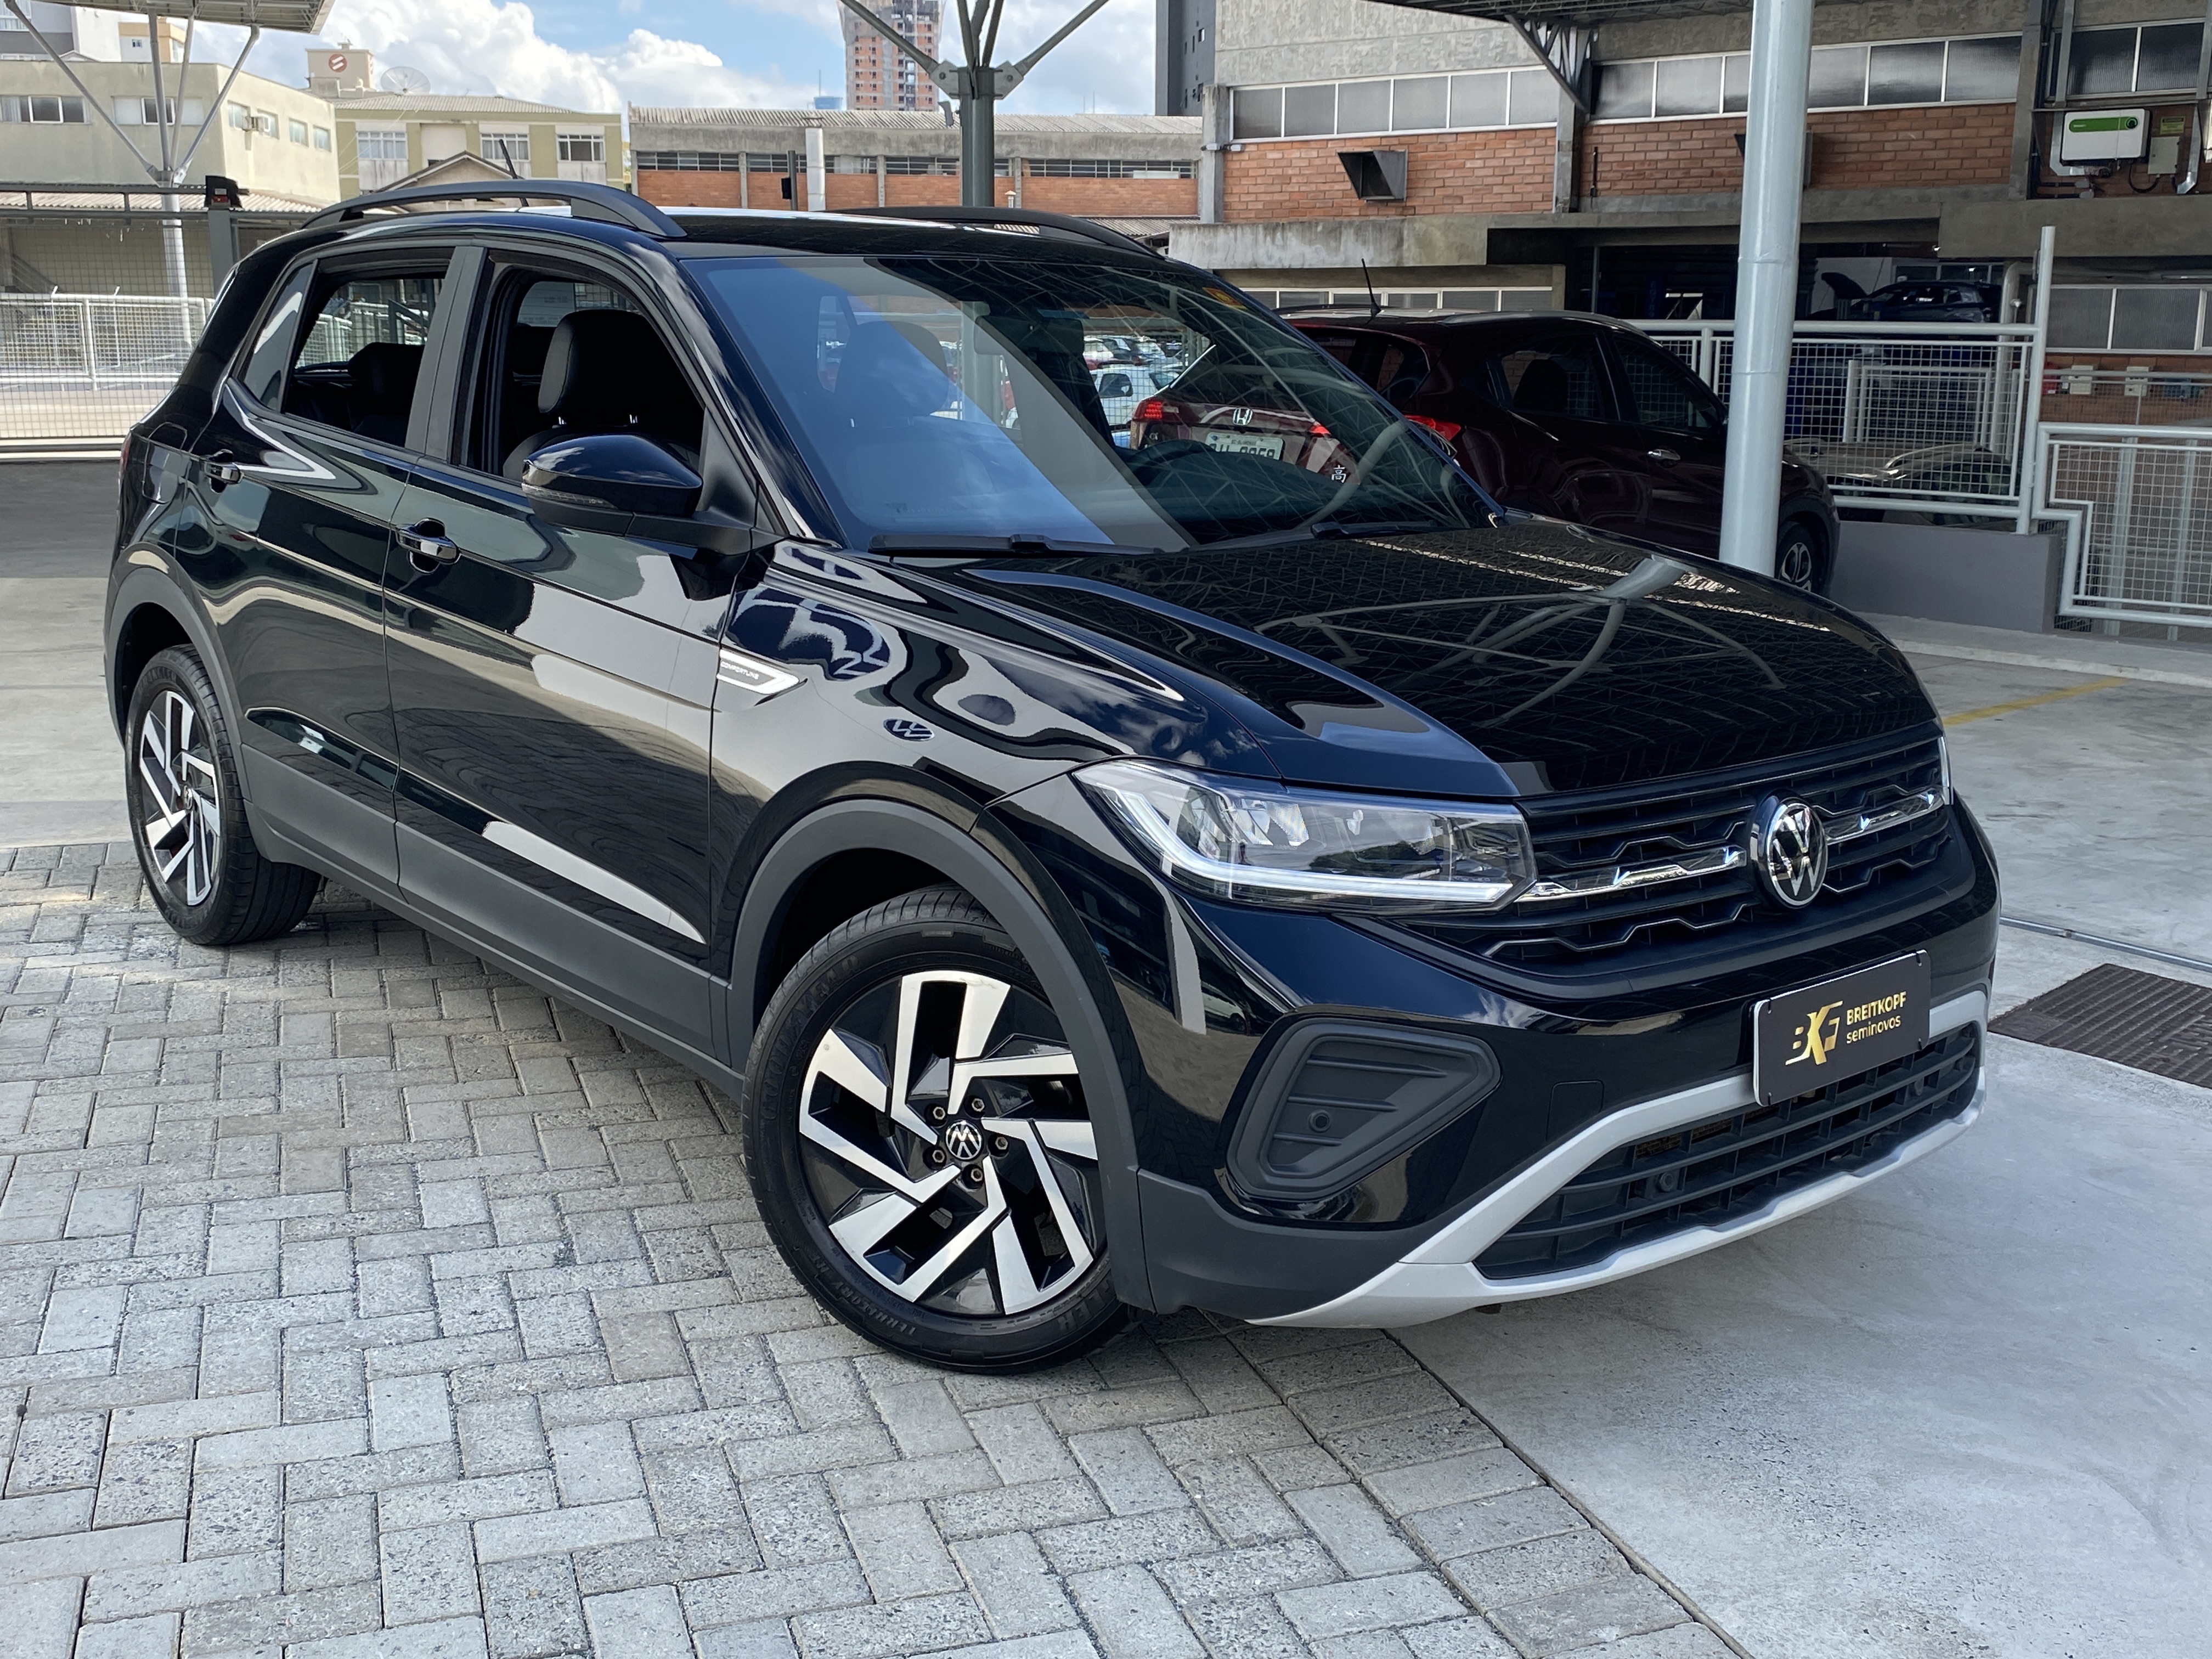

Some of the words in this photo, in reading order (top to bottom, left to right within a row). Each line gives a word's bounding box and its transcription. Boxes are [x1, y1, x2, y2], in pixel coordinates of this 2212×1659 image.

[1331, 465, 1347, 483] 高
[720, 661, 760, 680] COMFORTLINE
[1846, 991, 1907, 1025] BREITKOPF
[1846, 1015, 1901, 1044] seminovos
